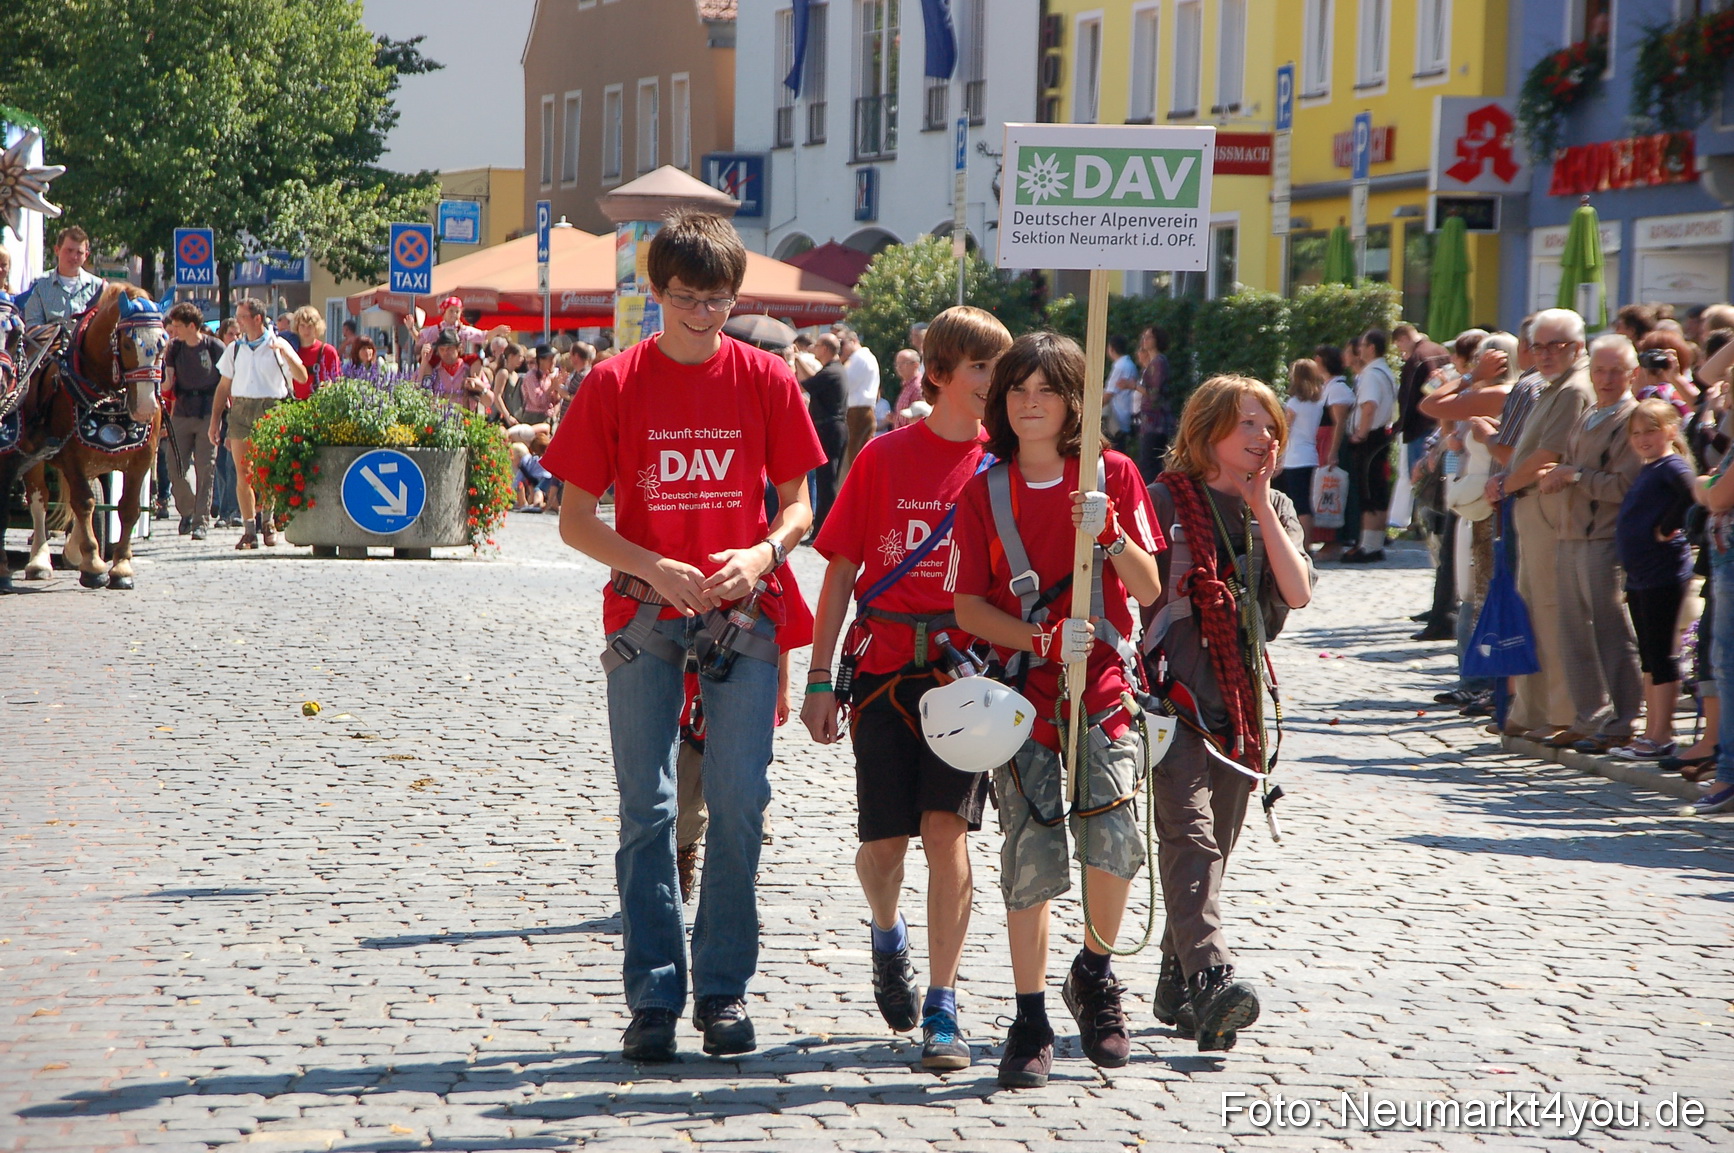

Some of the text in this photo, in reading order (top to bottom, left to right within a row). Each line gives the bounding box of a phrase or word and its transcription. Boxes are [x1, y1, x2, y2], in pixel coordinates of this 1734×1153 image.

[1073, 154, 1196, 200] DAV
[1013, 210, 1198, 230] Deutscher Alpenverein
[1011, 230, 1196, 247] Sektion Neumarkt i.d. OPf.
[179, 268, 211, 281] TAXI
[394, 272, 428, 288] TAXI
[648, 428, 742, 440] Zukunft schützen
[660, 449, 735, 481] DAV
[648, 503, 676, 512] Sektion
[897, 498, 941, 511] Zukunft
